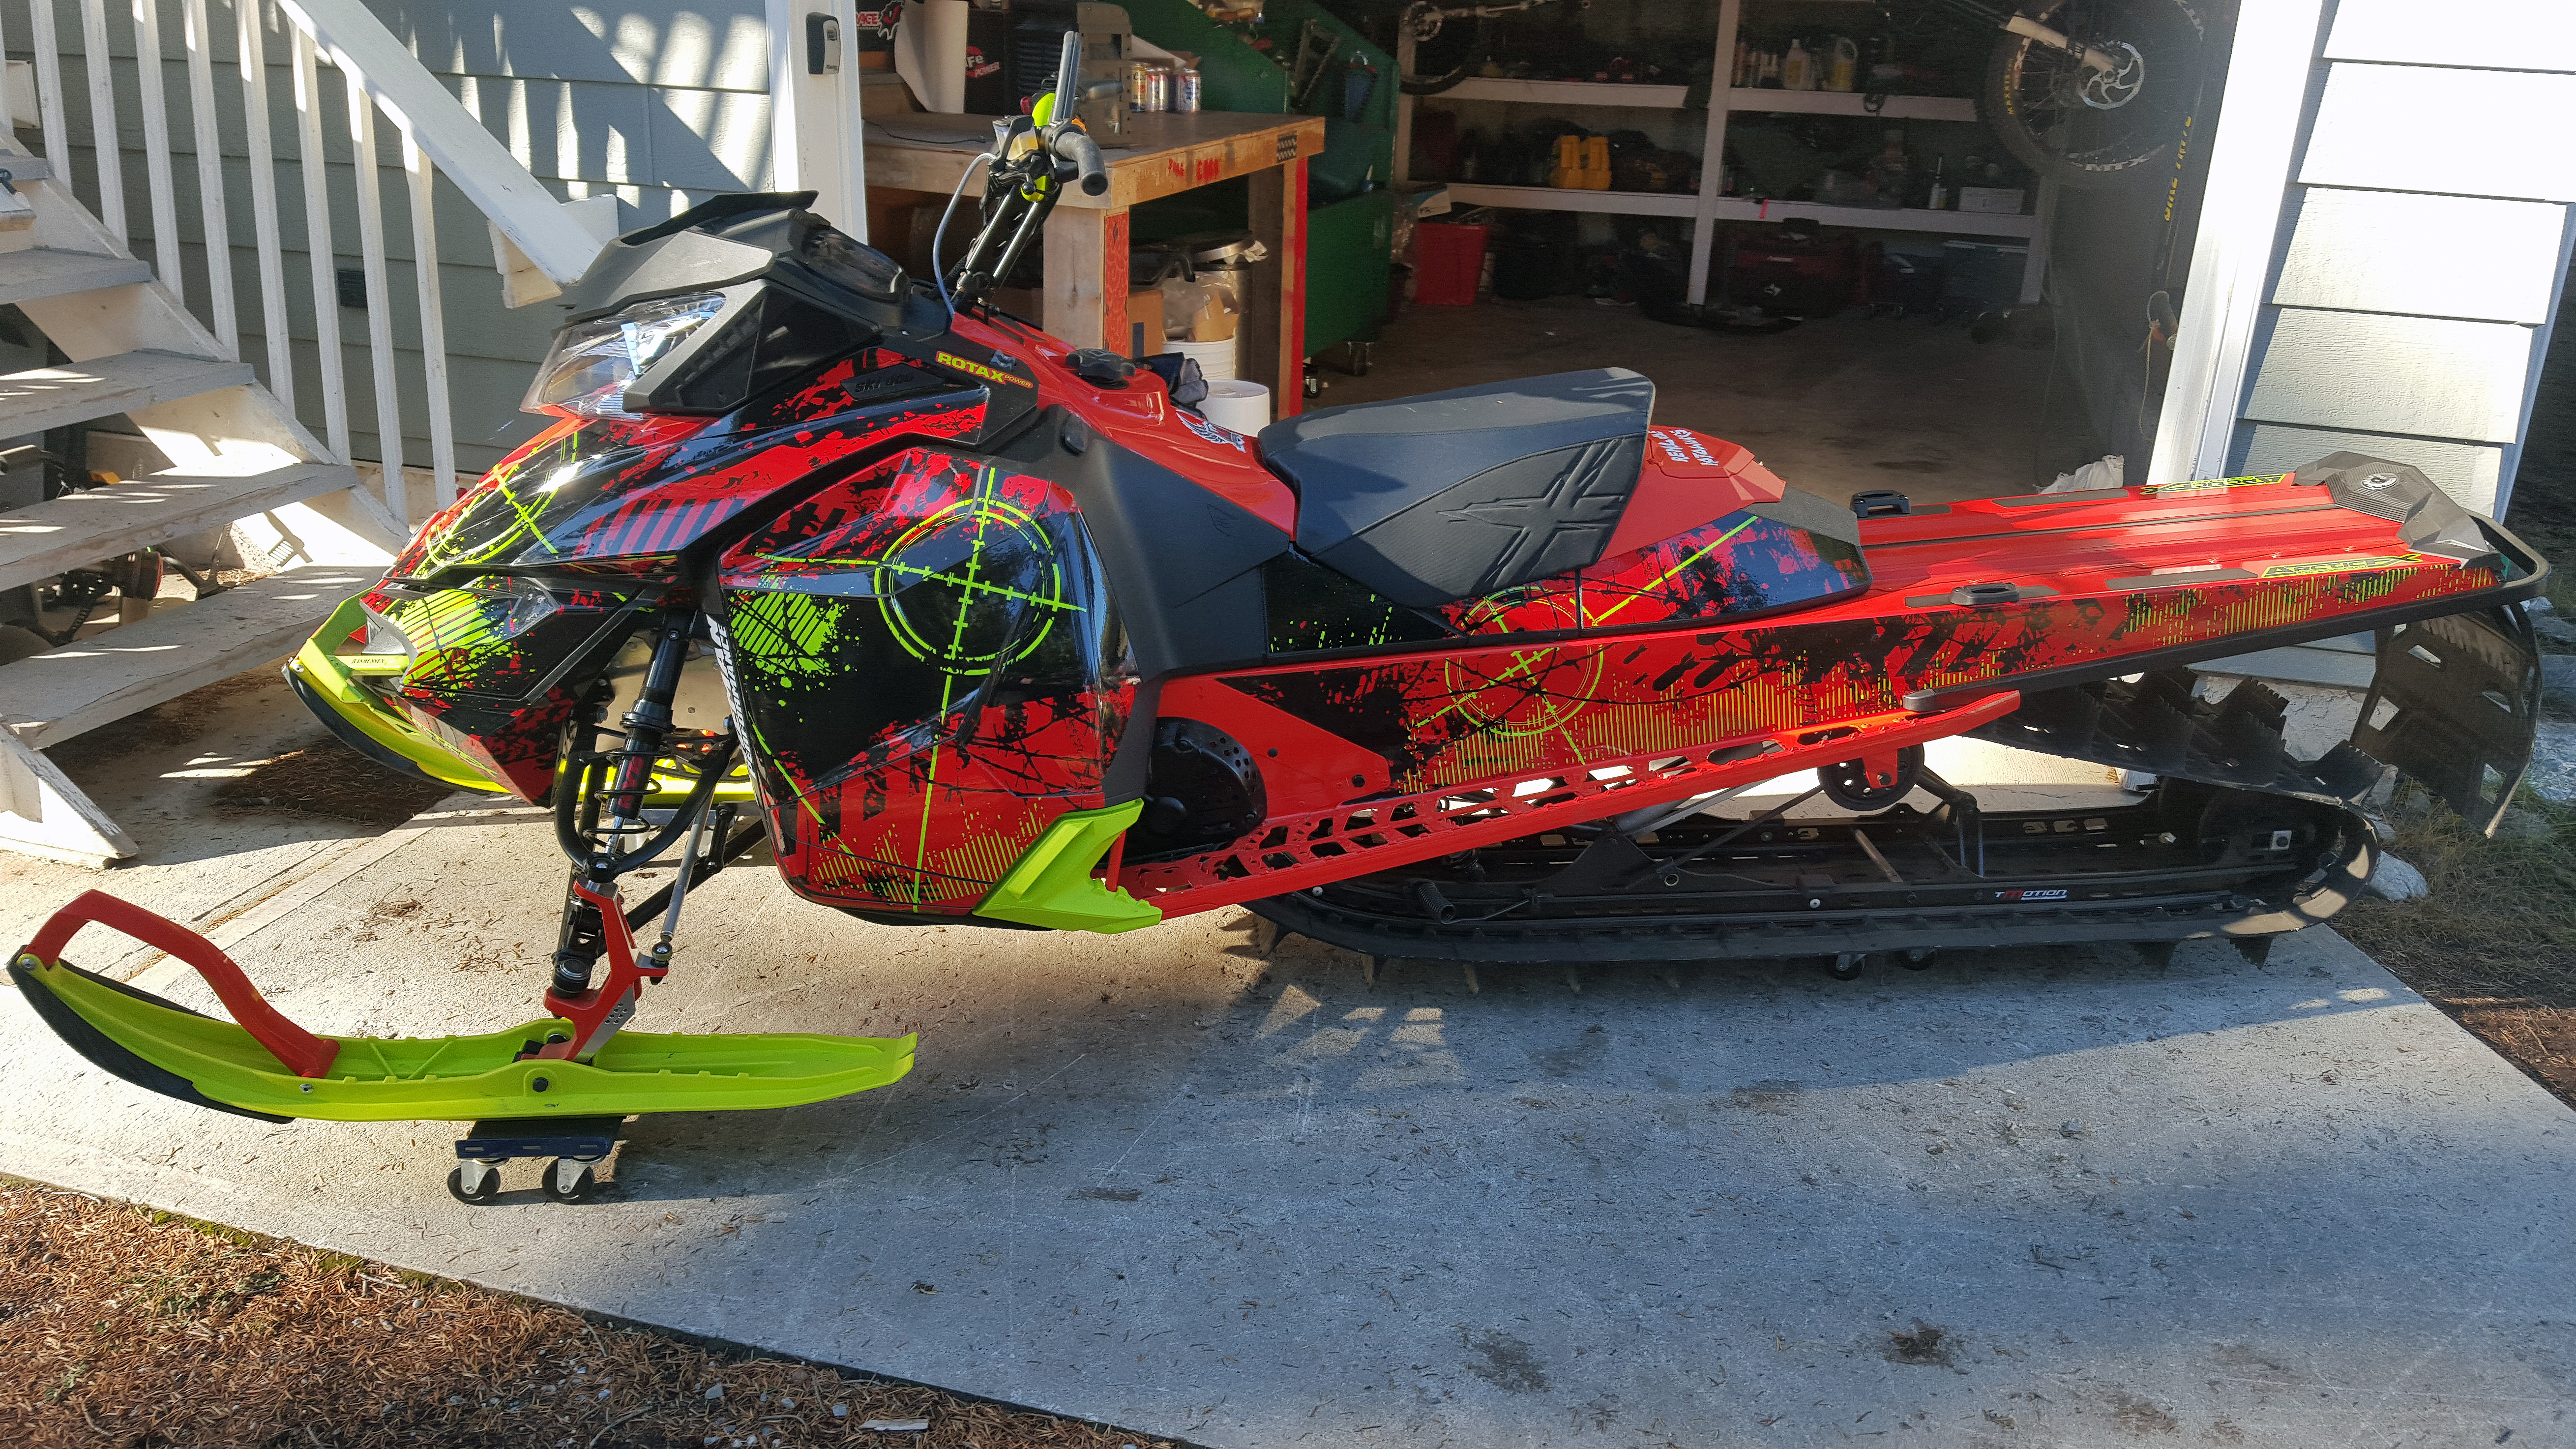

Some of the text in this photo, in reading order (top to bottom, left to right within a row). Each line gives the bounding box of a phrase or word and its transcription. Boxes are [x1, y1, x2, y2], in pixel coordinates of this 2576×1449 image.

[965, 55, 984, 68] Fe
[938, 352, 1032, 387] ROTAX POWER
[718, 623, 756, 779] PERFORMANCE
